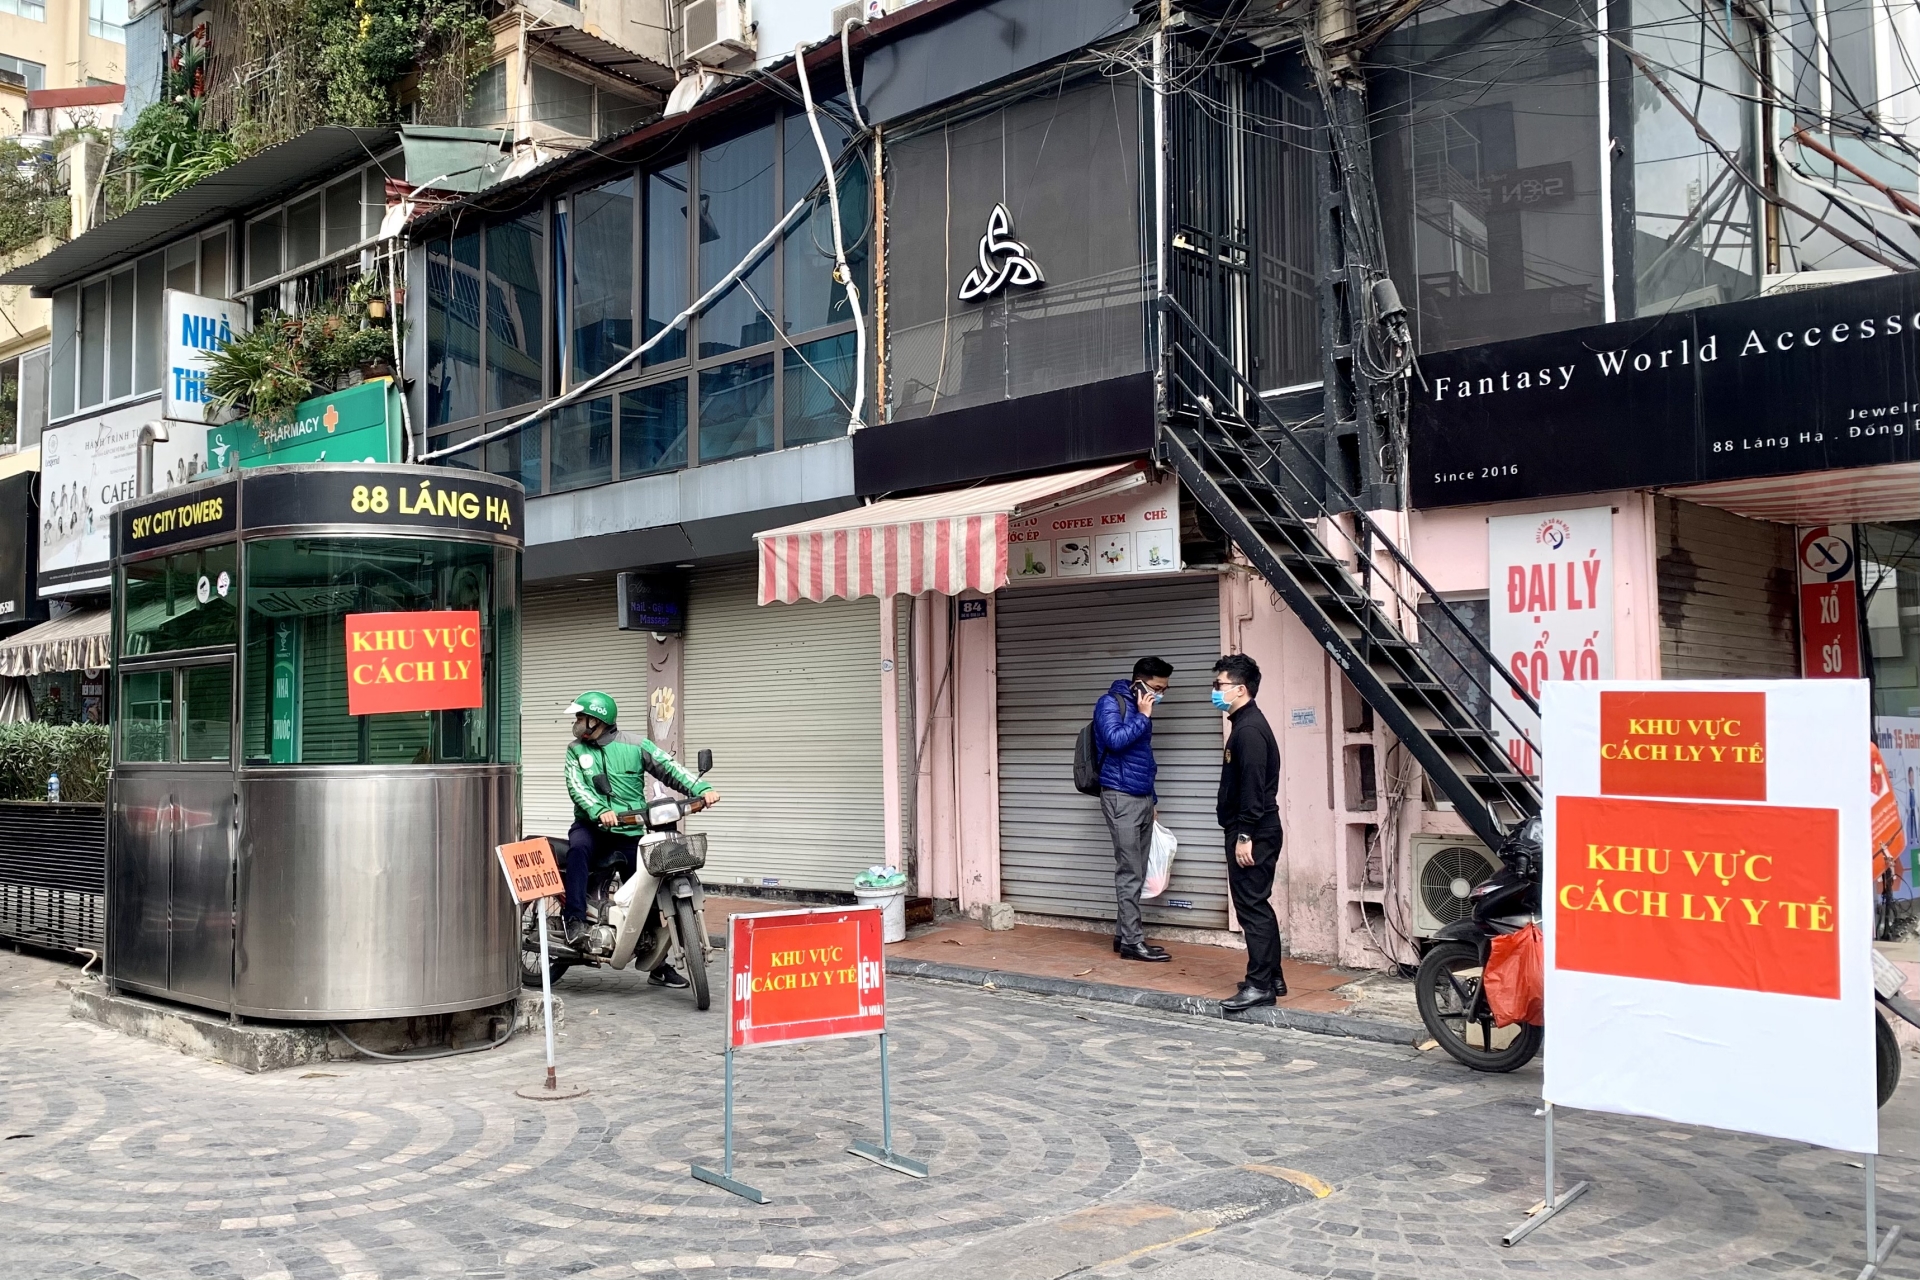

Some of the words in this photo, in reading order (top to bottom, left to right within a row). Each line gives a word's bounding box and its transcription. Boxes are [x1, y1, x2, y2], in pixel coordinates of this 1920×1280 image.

[181, 313, 232, 352] NHÀ
[1434, 364, 1576, 402] Fantasy
[1596, 334, 1719, 378] World
[262, 416, 320, 445] PHARMACY
[1712, 440, 1734, 453] 88
[1743, 434, 1790, 450] Láng
[1799, 431, 1824, 445] Hạ
[1849, 422, 1905, 439] Đống
[1434, 470, 1475, 484] Since
[1481, 464, 1519, 479] 2016
[101, 474, 135, 505] CAFÉ
[132, 514, 152, 540] SKY
[153, 507, 177, 535] CITY
[178, 496, 224, 528] TOWERS
[351, 484, 390, 514] 88
[399, 479, 481, 520] LÁNG
[486, 495, 512, 531] HẠ
[1052, 517, 1094, 530] COFFEE
[1101, 513, 1126, 526] KEM
[1144, 507, 1168, 521] CHÈ
[1507, 563, 1557, 624] ĐẠI
[1567, 549, 1601, 610] LÝ
[639, 614, 670, 627] Massage
[963, 601, 982, 613] 84
[352, 629, 415, 653] KHU
[422, 624, 476, 654] VỰC
[1822, 634, 1842, 674] SỐ
[353, 657, 436, 685] CÁCH
[443, 660, 473, 681] LY
[1629, 718, 1681, 736] KHU
[1687, 717, 1741, 741] VỰC
[1601, 739, 1668, 761] CÁCH
[1674, 745, 1704, 762] LY
[1709, 745, 1727, 763] Y
[1731, 742, 1764, 764] TẾ
[513, 853, 530, 870] KHU
[1586, 843, 1672, 875] KHU
[1682, 848, 1773, 887] VỰC
[1559, 879, 1670, 918] CÁCH
[1680, 893, 1732, 923] LY
[1740, 897, 1770, 926] Y
[1778, 896, 1834, 933] TẾ
[770, 950, 806, 968] KHU
[809, 945, 844, 967] VỰC
[751, 972, 797, 993] CÁCH
[801, 971, 819, 988] LY
[823, 970, 834, 986] Y
[837, 964, 857, 984] TẾ
[858, 955, 880, 994] IỆN
